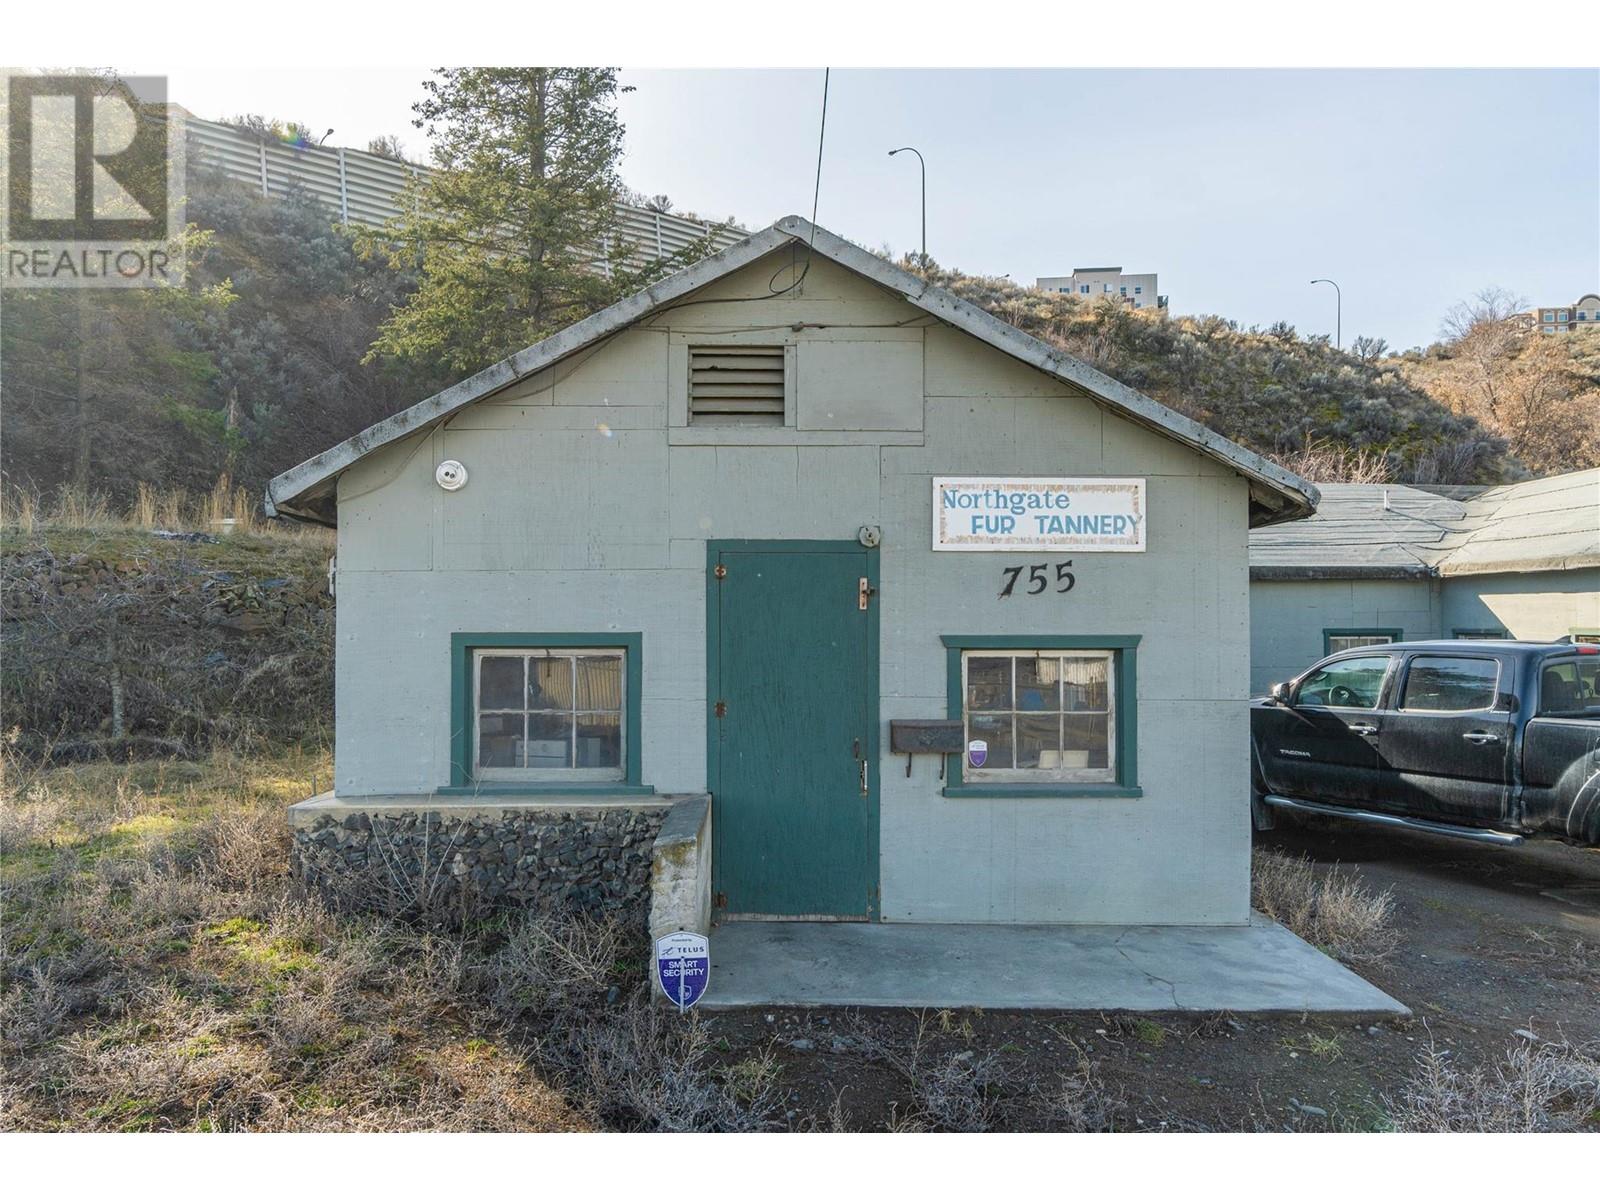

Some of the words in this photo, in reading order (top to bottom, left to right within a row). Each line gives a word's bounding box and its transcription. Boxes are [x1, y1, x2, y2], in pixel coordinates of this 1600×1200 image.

[942, 489, 1071, 516] Northgate
[970, 514, 1016, 535] FUR
[1033, 514, 1144, 536] TANNERY
[998, 559, 1076, 600] 755
[663, 968, 705, 977] SECRITY
